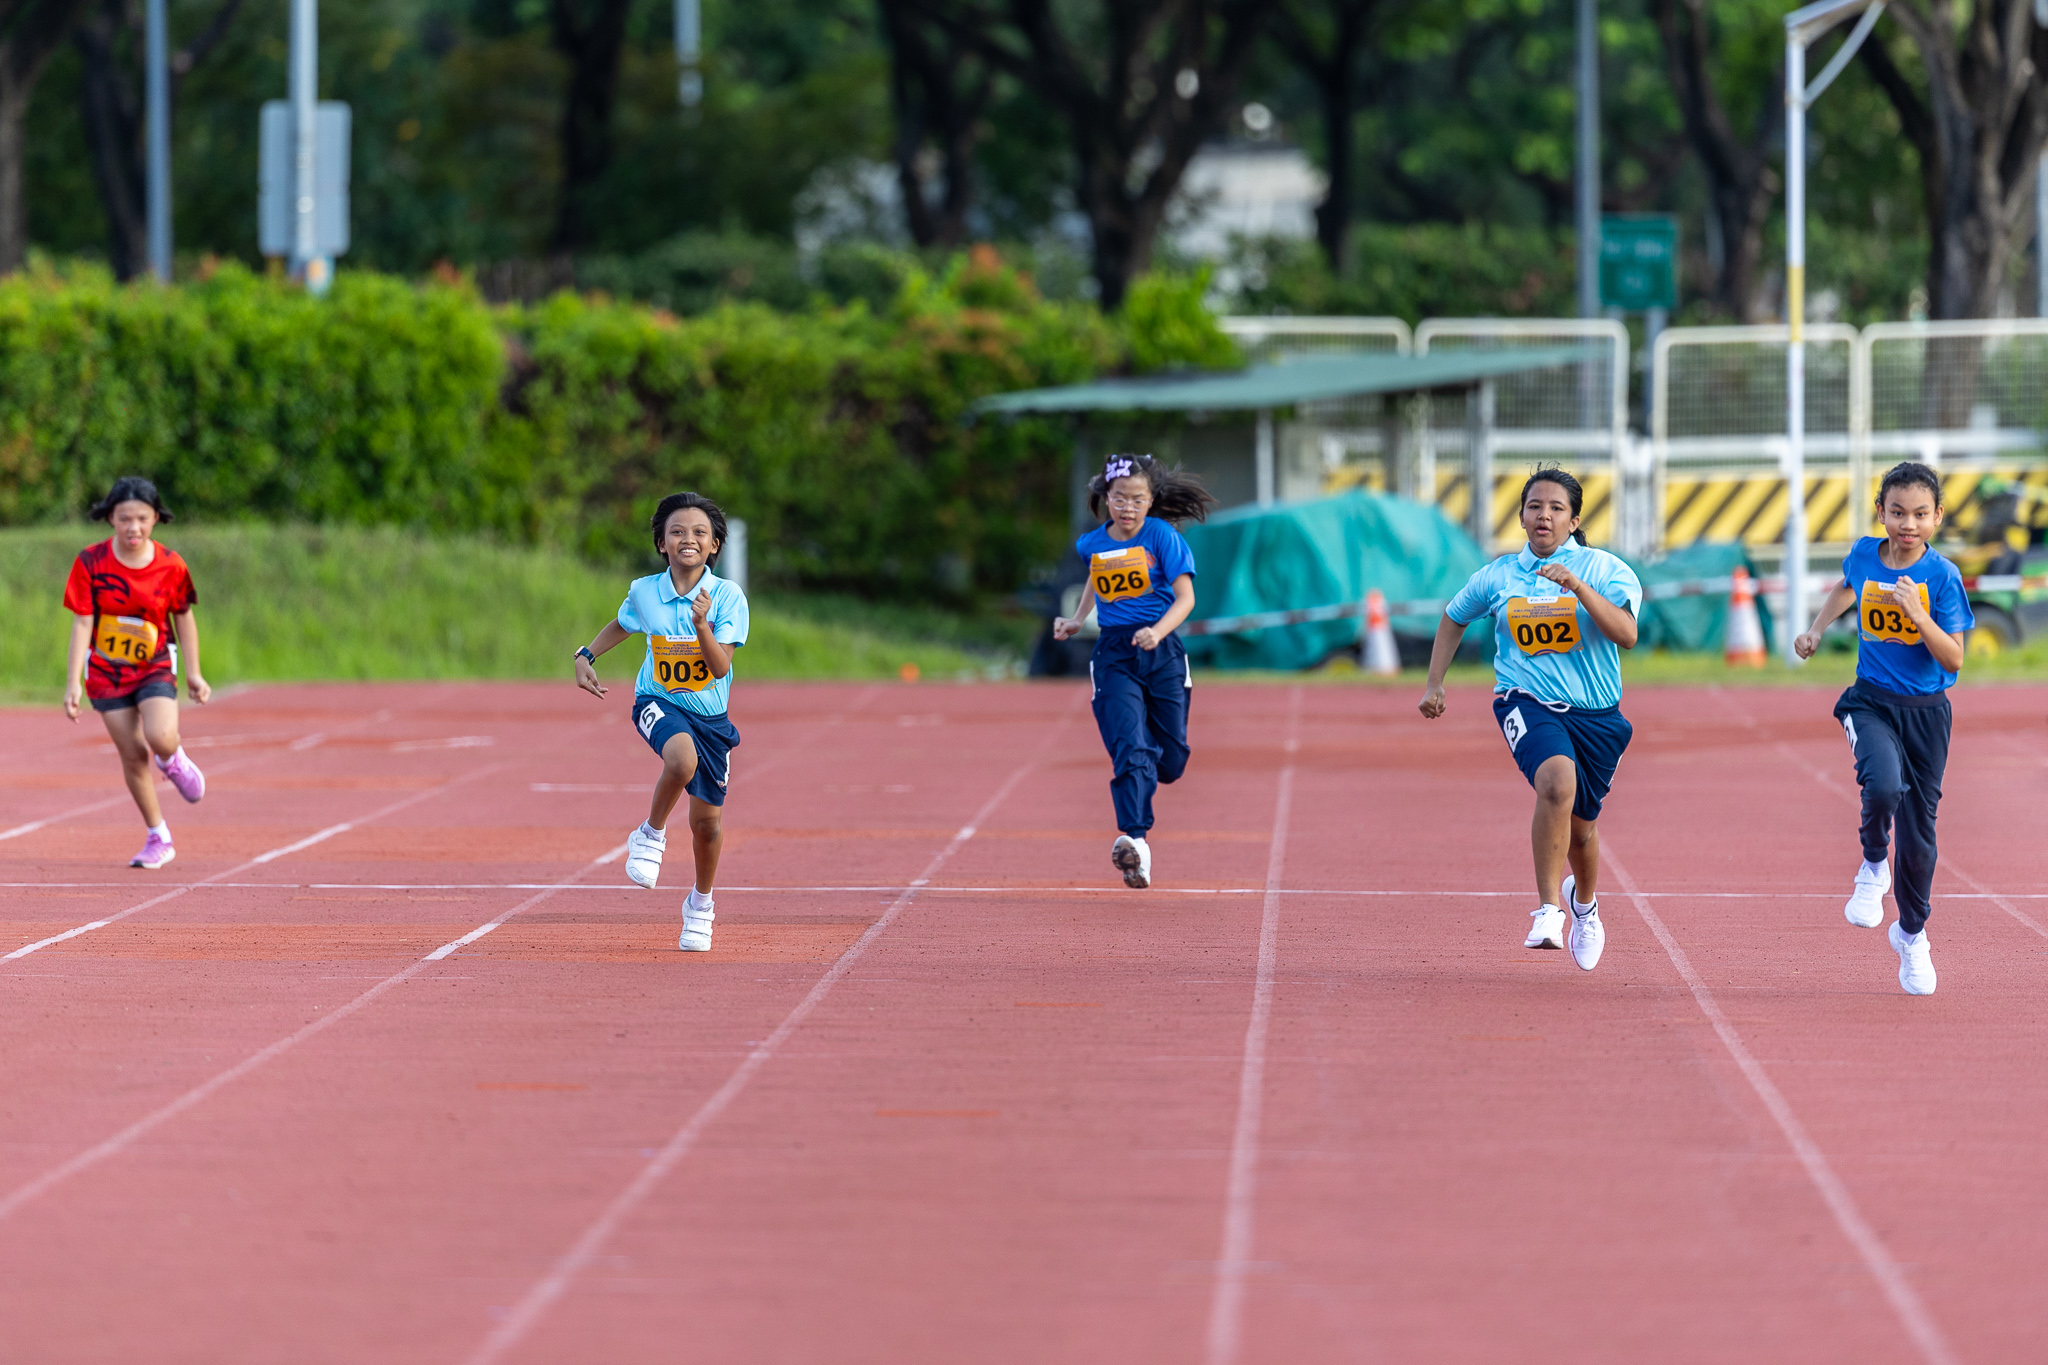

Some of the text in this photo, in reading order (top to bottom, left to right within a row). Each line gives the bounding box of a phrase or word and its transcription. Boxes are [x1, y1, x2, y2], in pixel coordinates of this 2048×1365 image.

[1097, 571, 1144, 594] 026
[1517, 622, 1573, 646] 002
[105, 636, 148, 660] 116
[659, 660, 709, 682] 003
[642, 708, 656, 729] 5
[1506, 718, 1519, 742] 3
